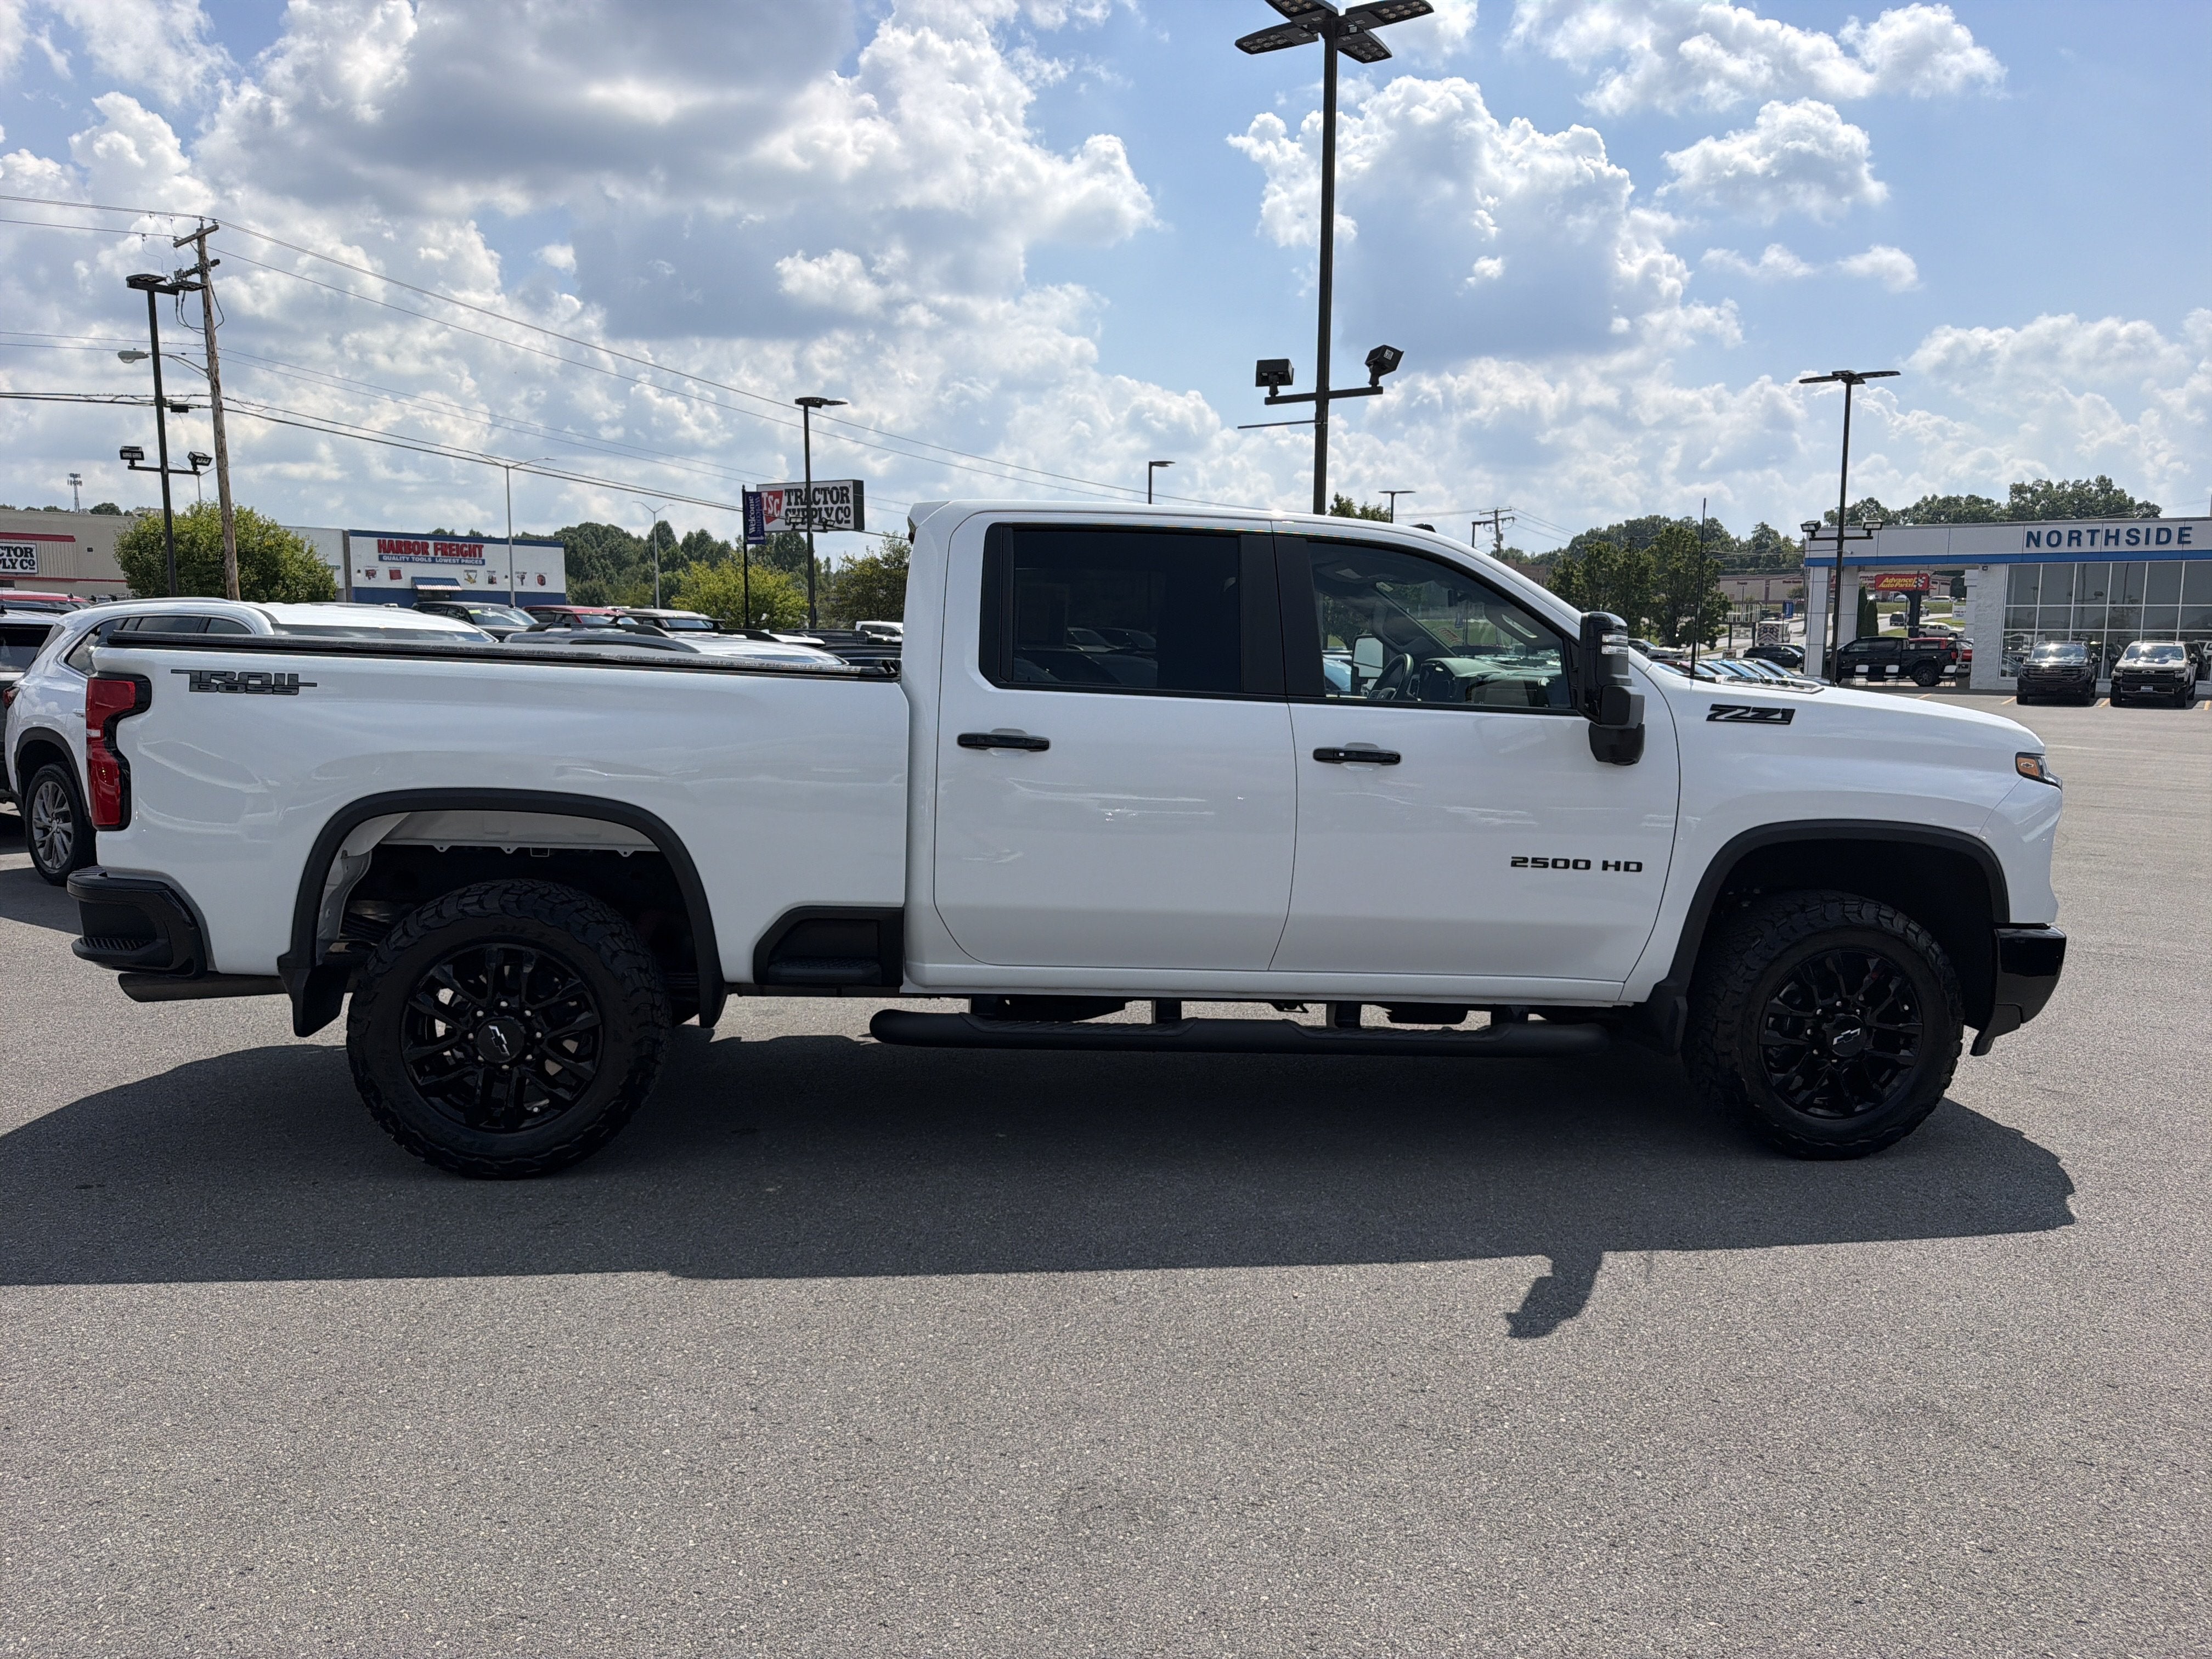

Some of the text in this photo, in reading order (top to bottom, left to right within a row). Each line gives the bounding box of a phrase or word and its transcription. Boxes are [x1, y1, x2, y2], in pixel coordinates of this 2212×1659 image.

[761, 492, 780, 517] TSC
[2025, 526, 2193, 548] NORTHSIDE
[377, 539, 484, 558] HARBOR FREIGHT
[171, 669, 317, 686] TRAIL
[189, 682, 300, 696] BOSS
[1706, 703, 1796, 725] Z71
[1510, 856, 1643, 872] 2500 HD
